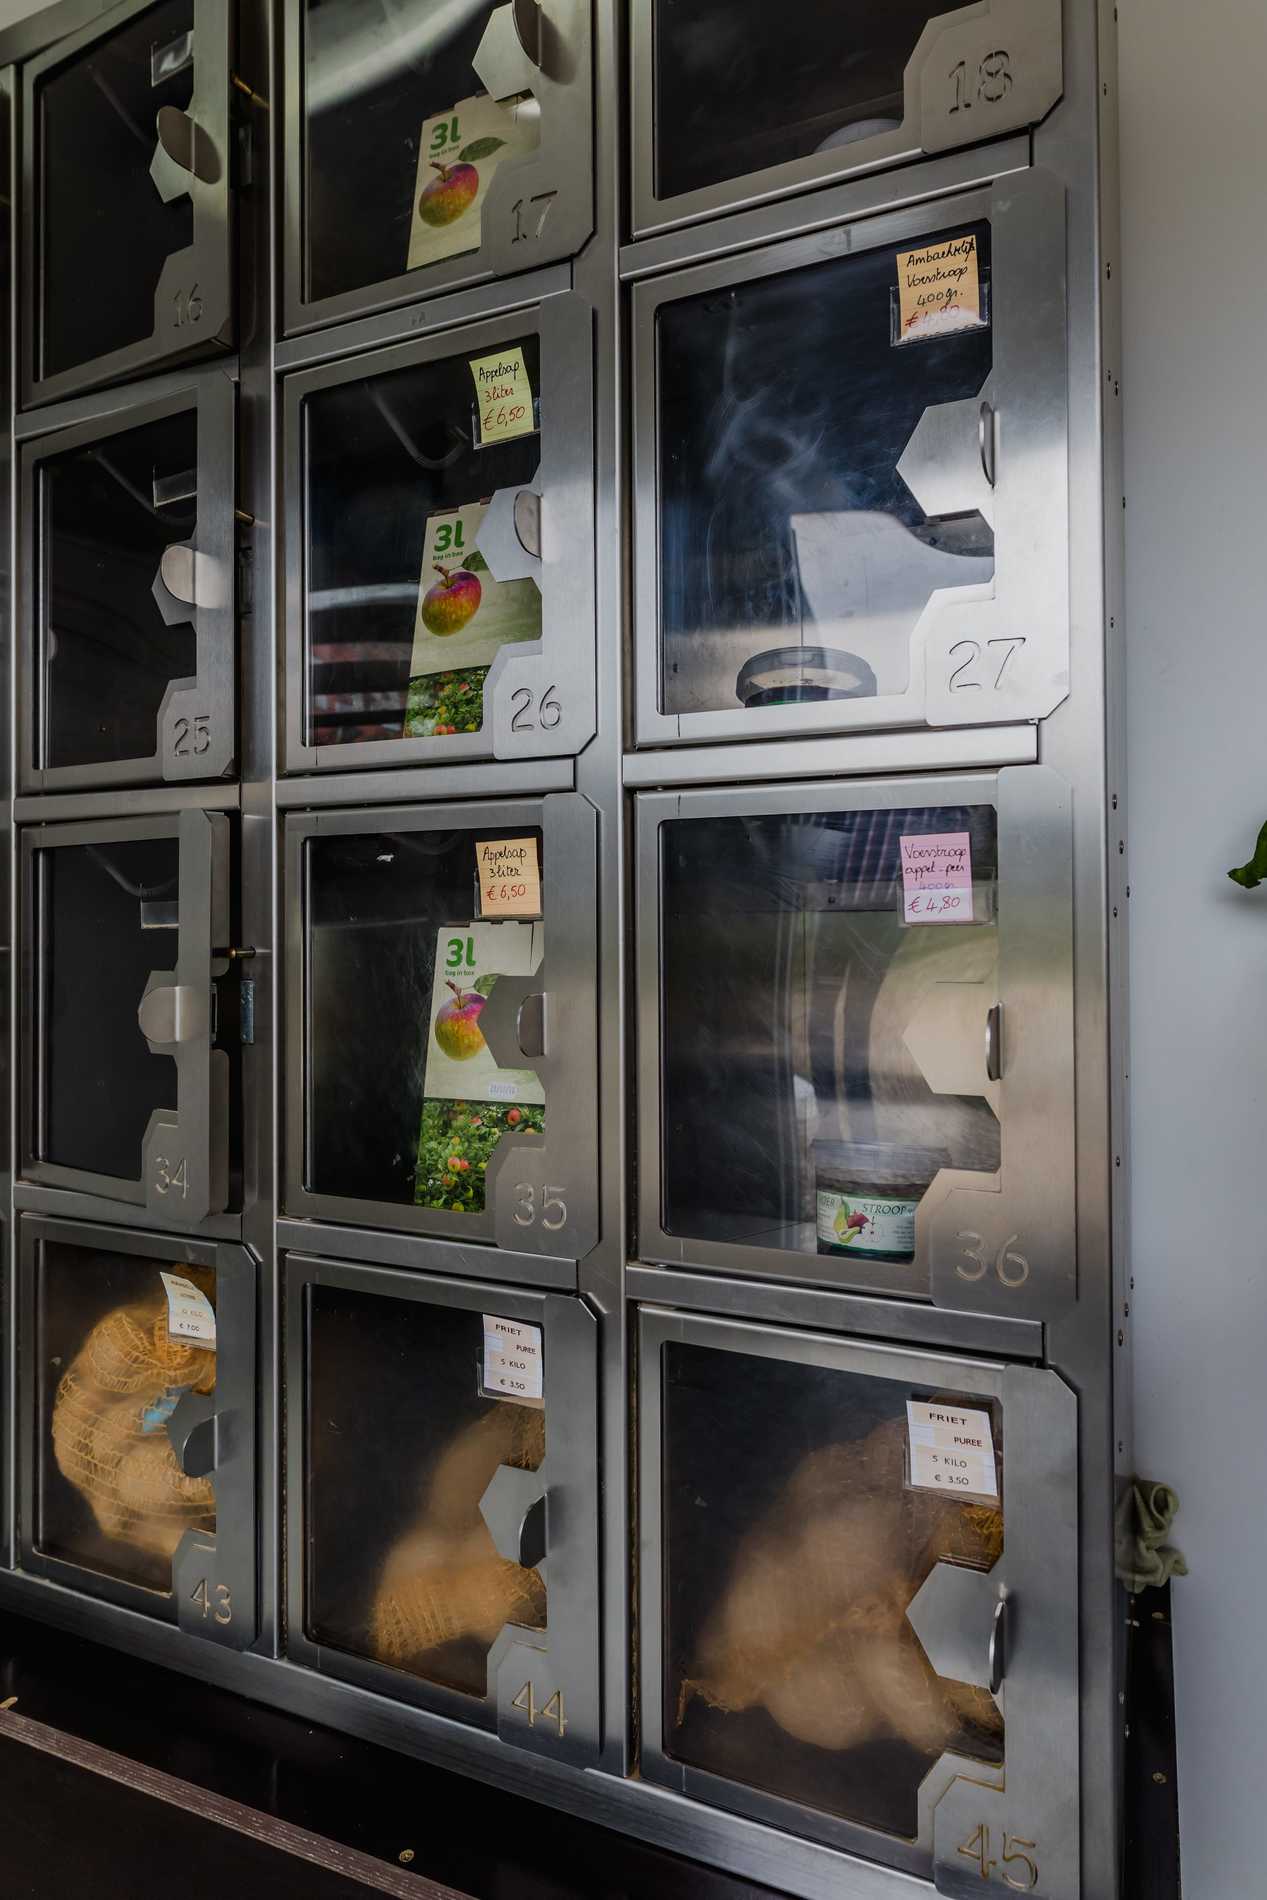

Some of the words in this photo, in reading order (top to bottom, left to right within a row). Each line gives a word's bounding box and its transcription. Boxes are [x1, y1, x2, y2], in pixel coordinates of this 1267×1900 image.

[948, 49, 1013, 114] 18
[511, 190, 558, 244] 17
[173, 283, 208, 328] 16
[479, 361, 520, 383] Appelsap
[948, 636, 1026, 693] 27
[511, 684, 562, 731] 26
[174, 715, 211, 757] 25
[483, 846, 527, 865] Appelsap
[155, 1157, 191, 1200] 34
[512, 1181, 568, 1231] 35
[863, 1203, 907, 1215] STROOP
[954, 1231, 1031, 1288] 36
[495, 1324, 522, 1336] FRIET
[516, 1344, 537, 1355] PUREE
[500, 1358, 506, 1366] 5
[509, 1360, 526, 1370] KILO
[929, 1412, 968, 1426] FRIET
[931, 1455, 939, 1463] 5
[944, 1457, 968, 1469] KILO
[954, 1436, 983, 1448] PUREE
[934, 1474, 942, 1482] €
[190, 1578, 233, 1625] 43
[511, 1680, 568, 1738] 44
[957, 1824, 1039, 1889] 45
